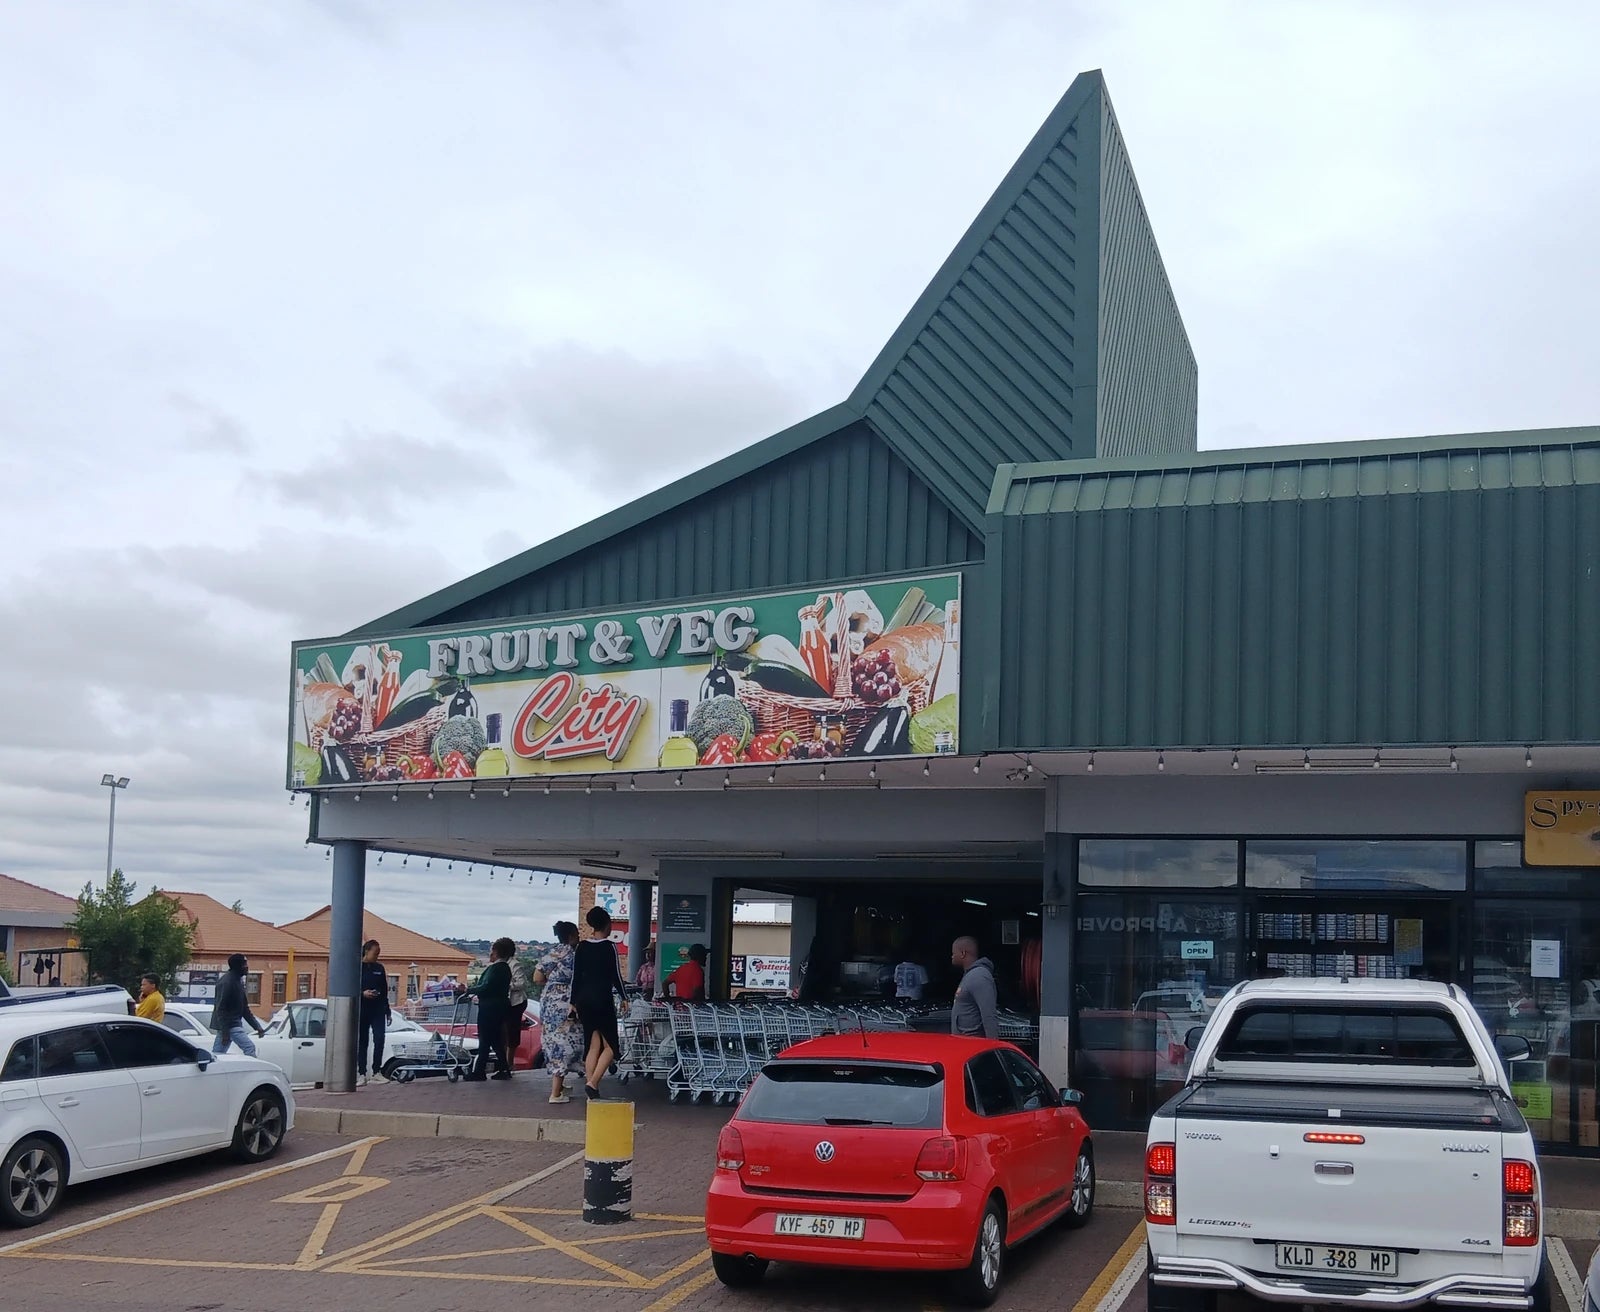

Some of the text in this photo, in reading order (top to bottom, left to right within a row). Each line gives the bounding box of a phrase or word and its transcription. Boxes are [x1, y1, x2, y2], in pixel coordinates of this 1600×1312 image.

[426, 606, 759, 679] FRUIT & VEG
[511, 671, 648, 761] City
[1529, 797, 1600, 829] Spy-
[731, 961, 743, 972] 14
[1184, 1131, 1222, 1141] TOYOTA
[1442, 1143, 1490, 1153] HILUX
[780, 1217, 860, 1236] KYF 659 MP
[1189, 1218, 1236, 1227] LEGEND
[1461, 1238, 1491, 1246] 4x4
[1283, 1246, 1391, 1271] KLD 328 MP
